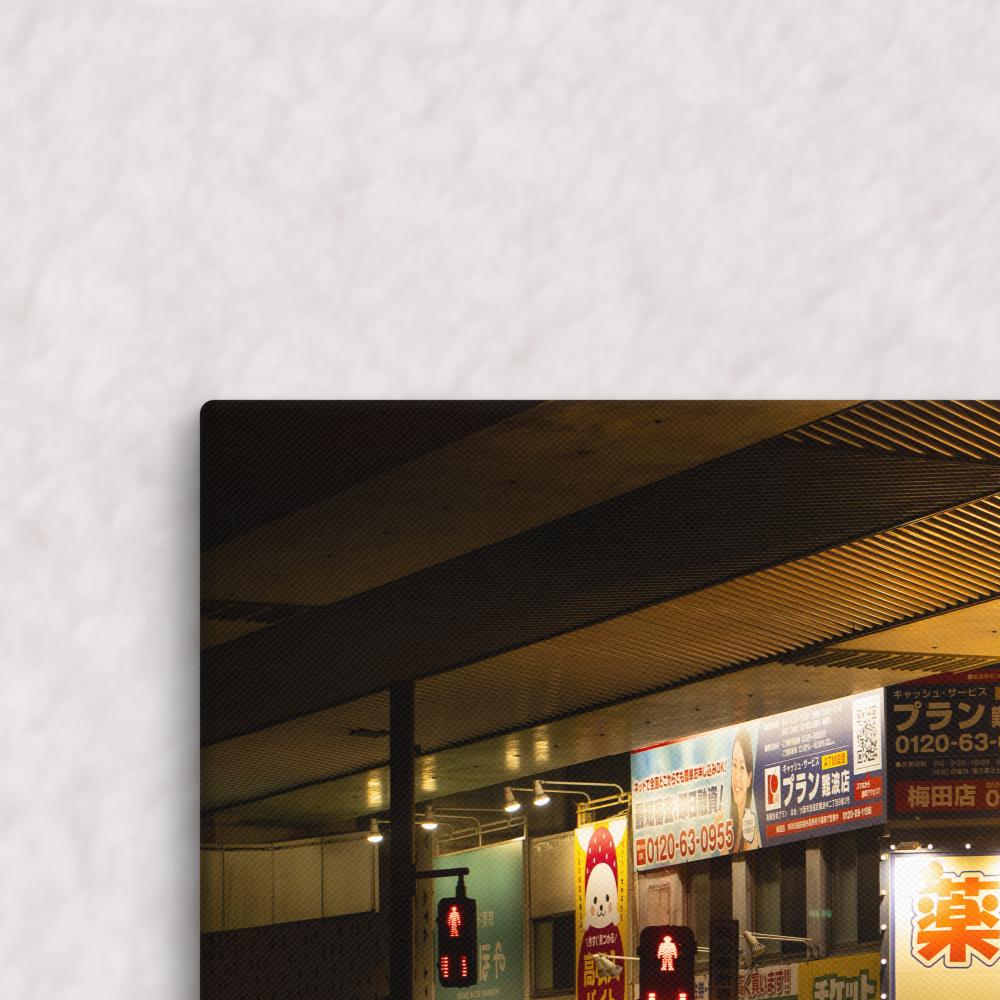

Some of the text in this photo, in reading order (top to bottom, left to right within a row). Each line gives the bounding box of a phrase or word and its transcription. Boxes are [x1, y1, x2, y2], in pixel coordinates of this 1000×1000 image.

[893, 686, 988, 699] キャッシュ・サービス
[893, 701, 987, 731] プラン
[782, 773, 820, 807] プラン
[908, 783, 977, 808] 梅田店
[647, 819, 736, 865] 0120-63-0955
